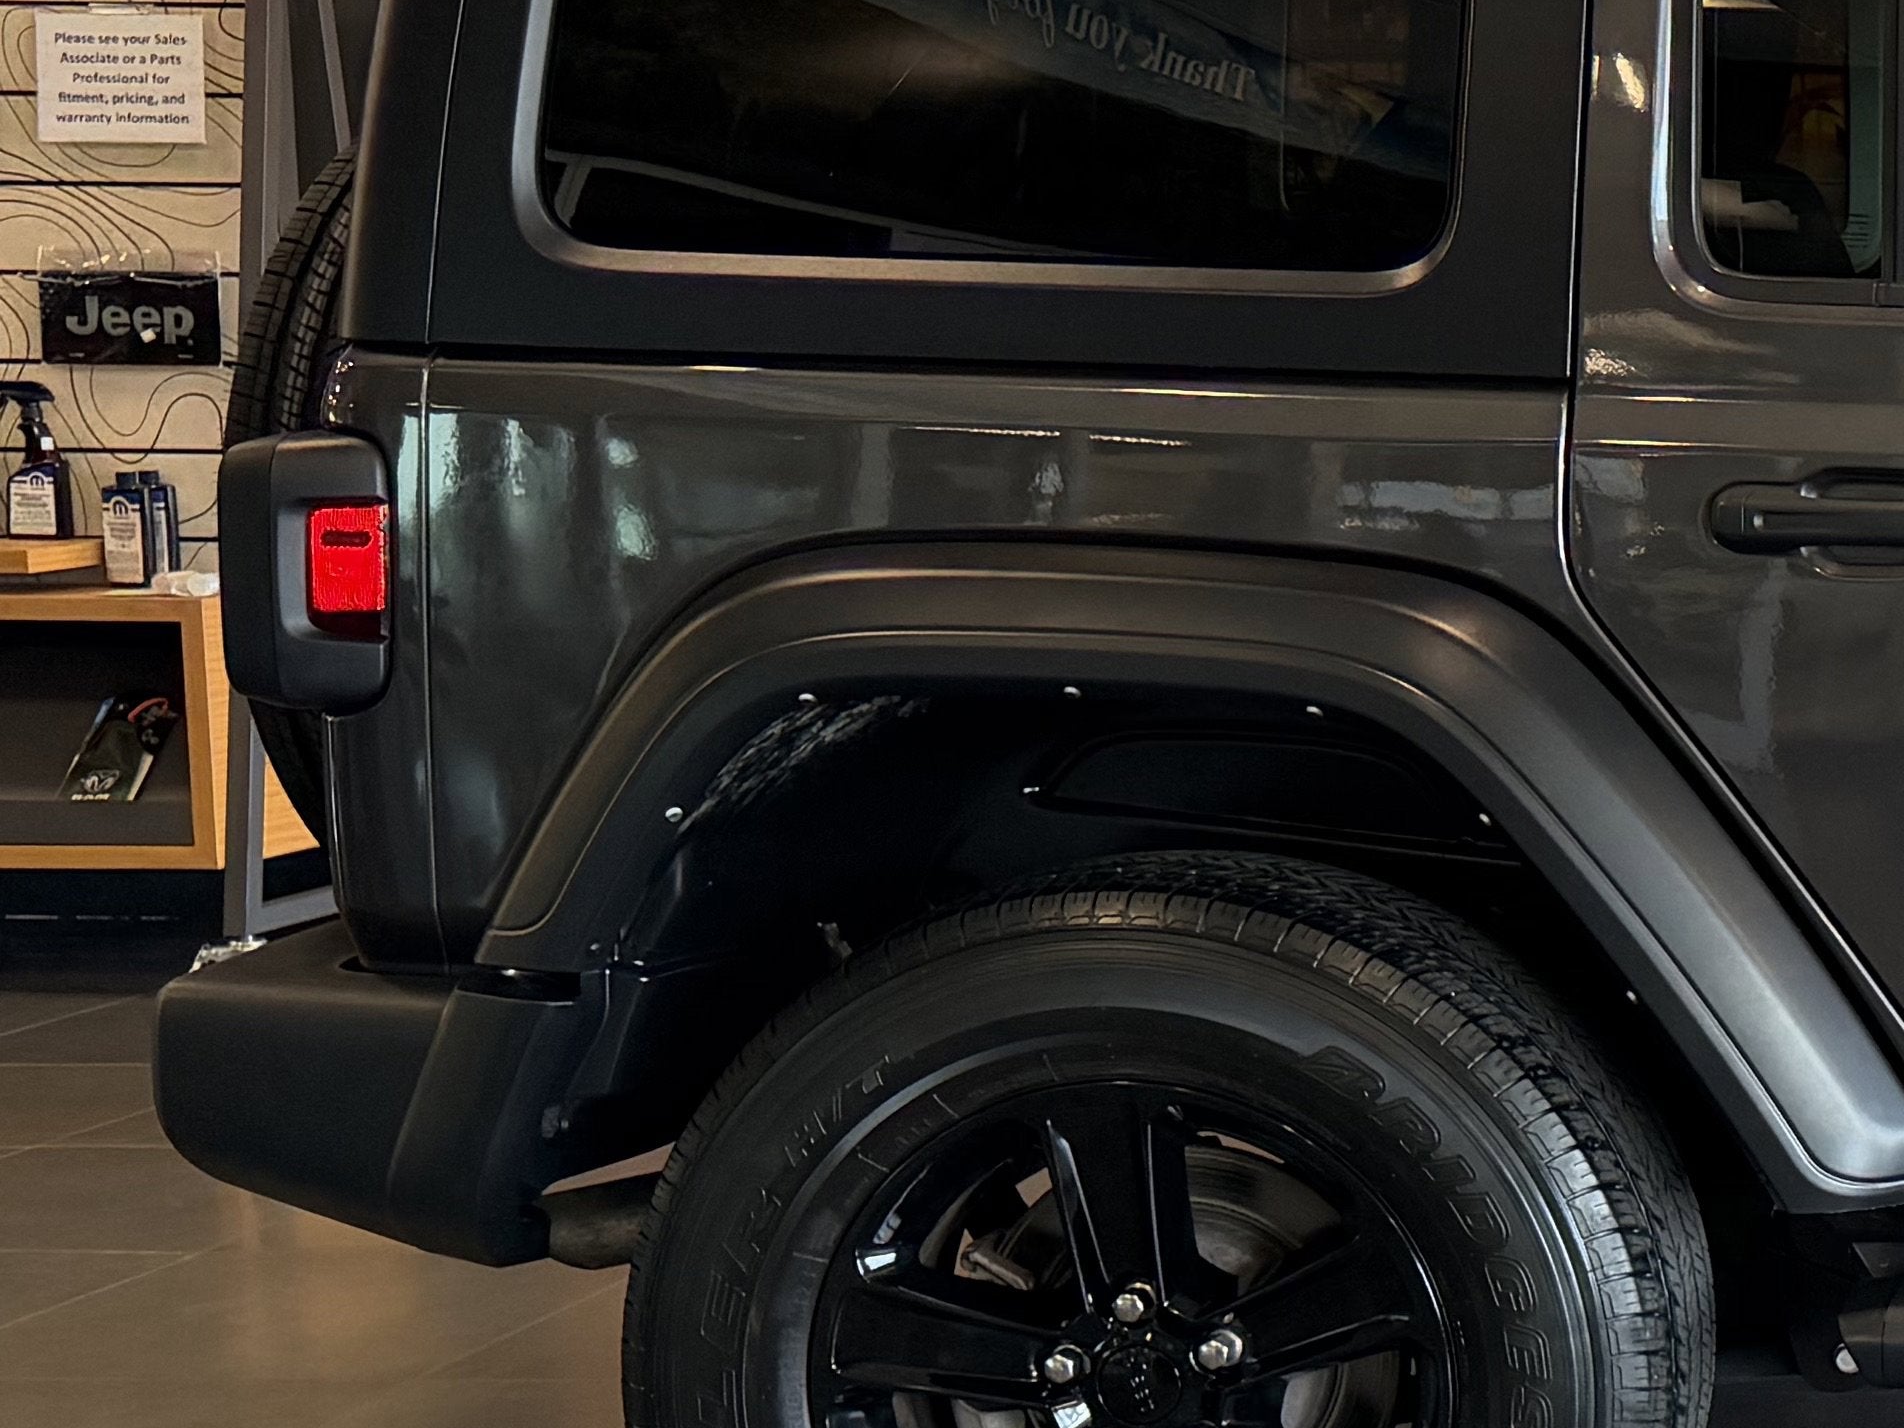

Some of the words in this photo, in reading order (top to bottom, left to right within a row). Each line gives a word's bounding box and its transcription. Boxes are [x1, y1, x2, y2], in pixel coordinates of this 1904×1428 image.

[54, 32, 95, 44] Please
[98, 35, 119, 44] see
[122, 35, 150, 46] your
[154, 33, 187, 45] Sales
[60, 52, 119, 64] Associate
[123, 55, 136, 64] or
[139, 55, 146, 64] a
[150, 54, 181, 65] Parts
[73, 73, 148, 84] Professional
[152, 73, 170, 84] for
[58, 92, 109, 105] fitment,
[112, 93, 159, 106] pricing,
[162, 94, 185, 104] and
[56, 113, 112, 125] warranty
[115, 113, 190, 124] information
[65, 295, 195, 345] Jeep
